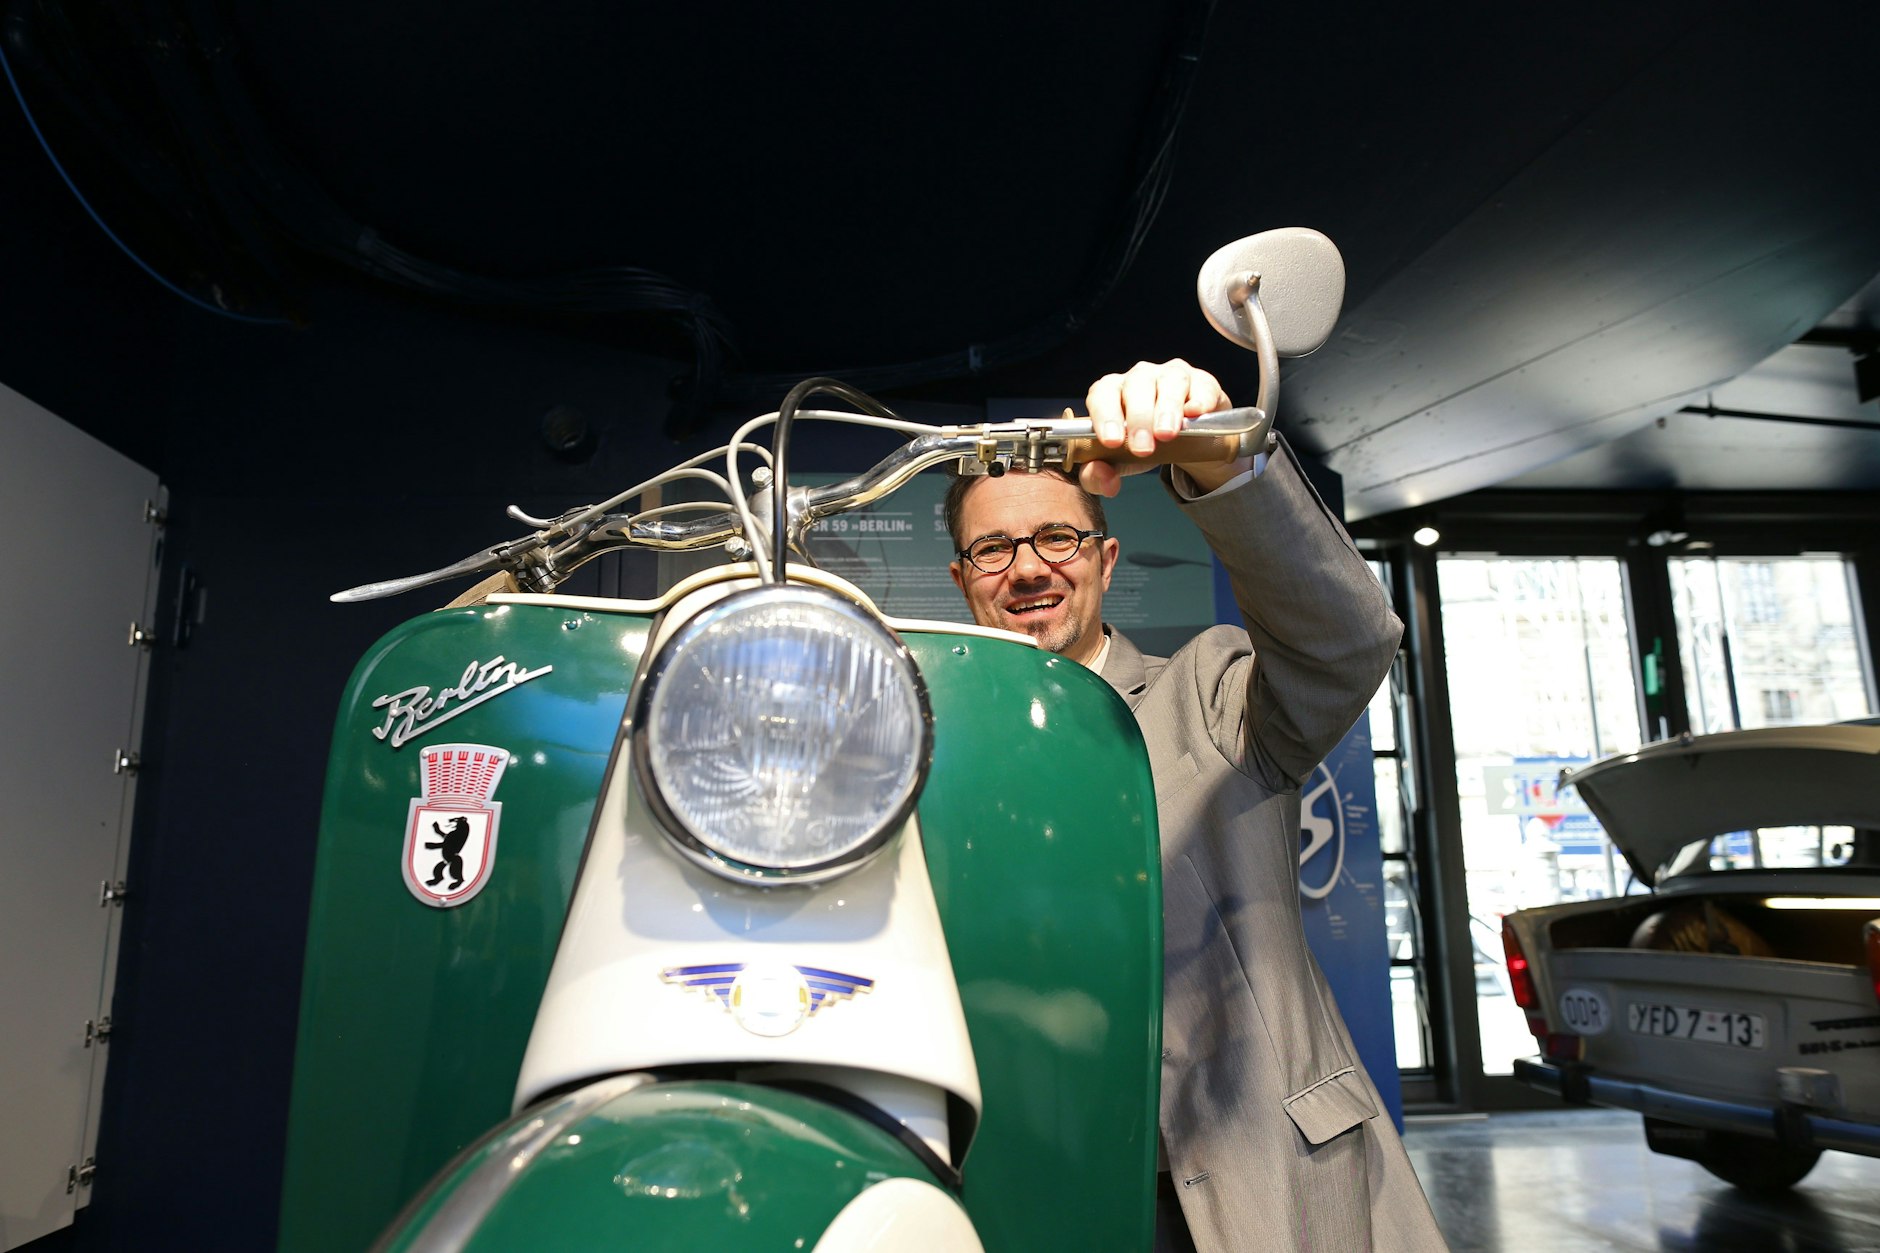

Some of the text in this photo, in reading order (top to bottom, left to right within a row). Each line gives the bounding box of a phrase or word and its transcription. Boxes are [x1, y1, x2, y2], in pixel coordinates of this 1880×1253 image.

[832, 519, 849, 532] 59
[372, 655, 553, 748] Berlin
[1564, 996, 1601, 1026] DDR
[1636, 1004, 1680, 1036] YFD
